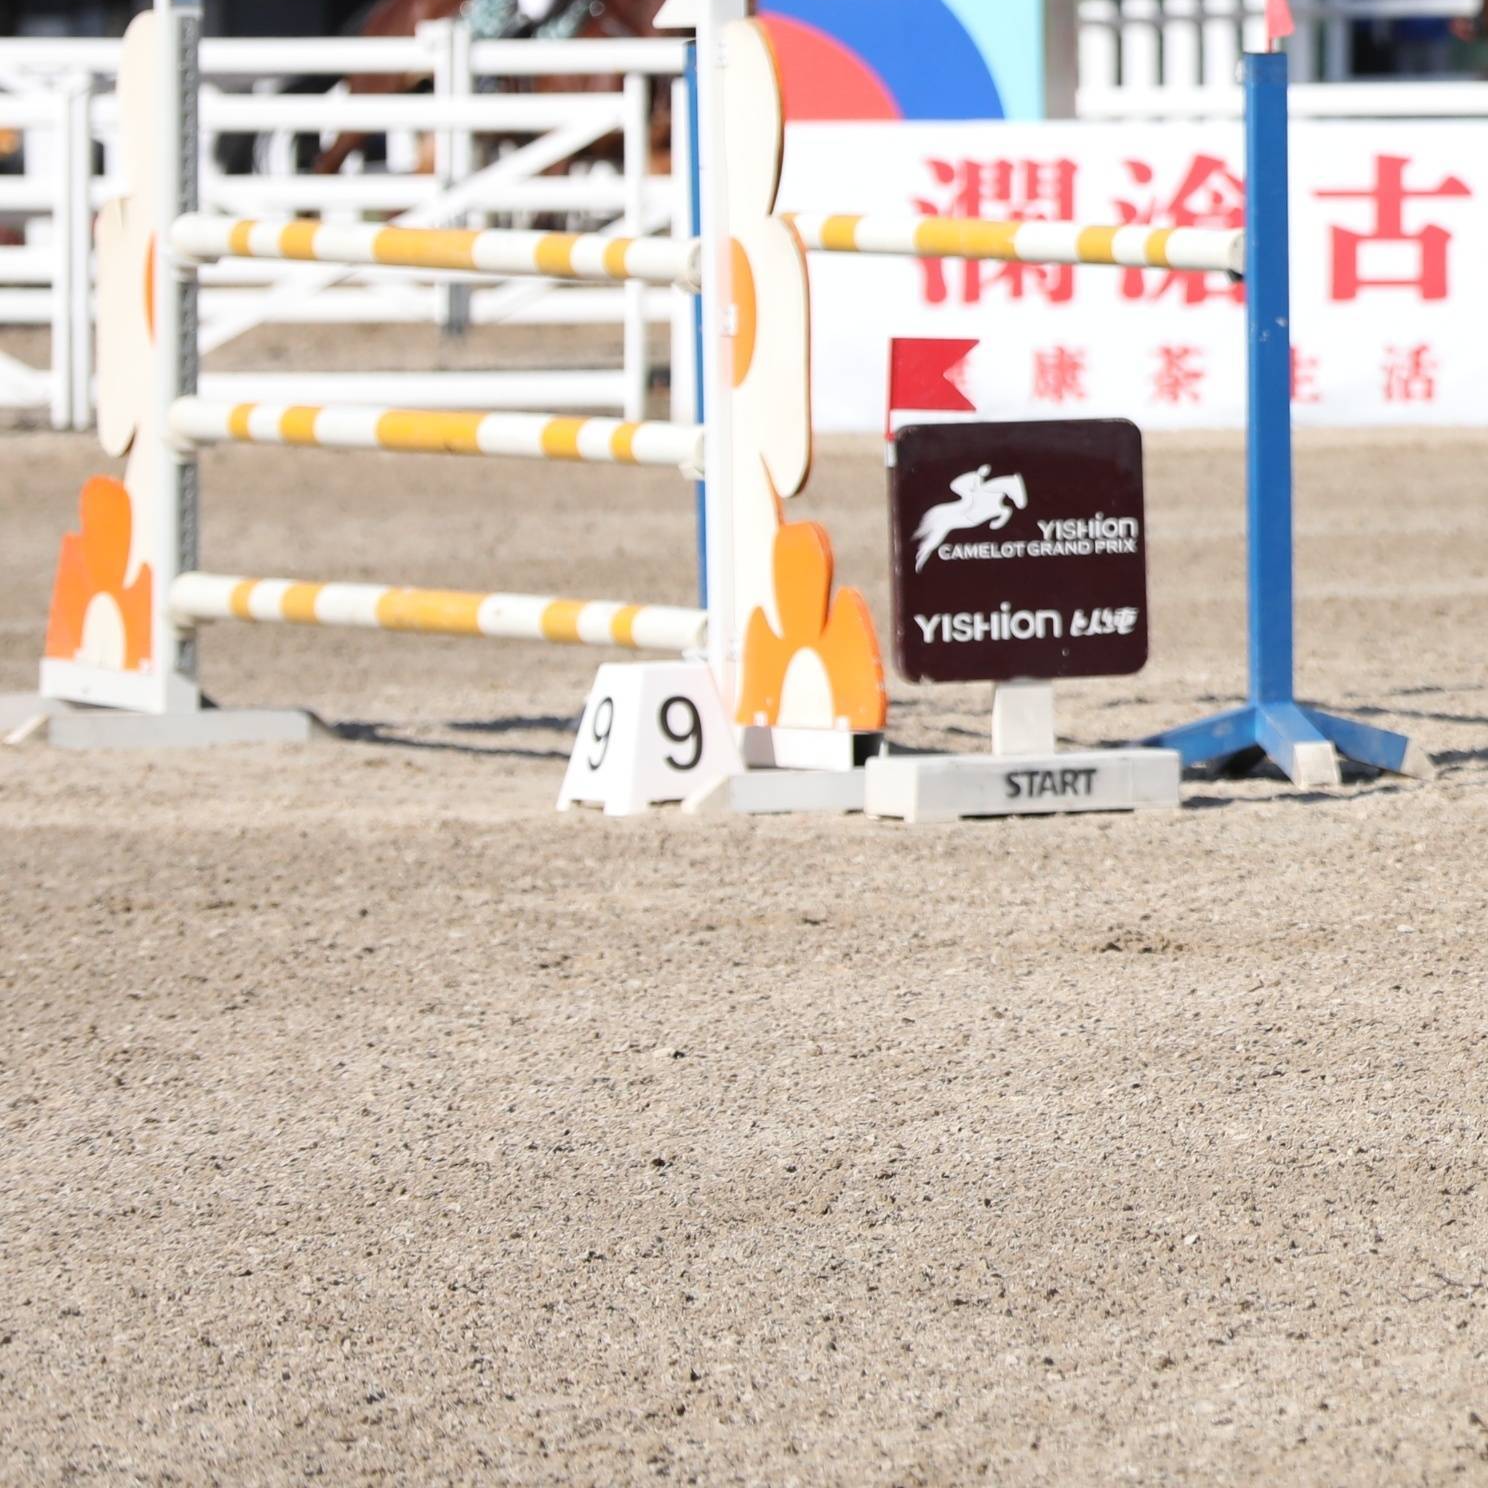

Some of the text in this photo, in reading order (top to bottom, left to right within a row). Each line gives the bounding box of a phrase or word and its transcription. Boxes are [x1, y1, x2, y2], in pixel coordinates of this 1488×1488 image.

[938, 538, 1138, 561] CAMELOT GRAND PRIX
[586, 695, 614, 771] 9
[658, 695, 703, 771] 9
[1004, 768, 1097, 799] START
